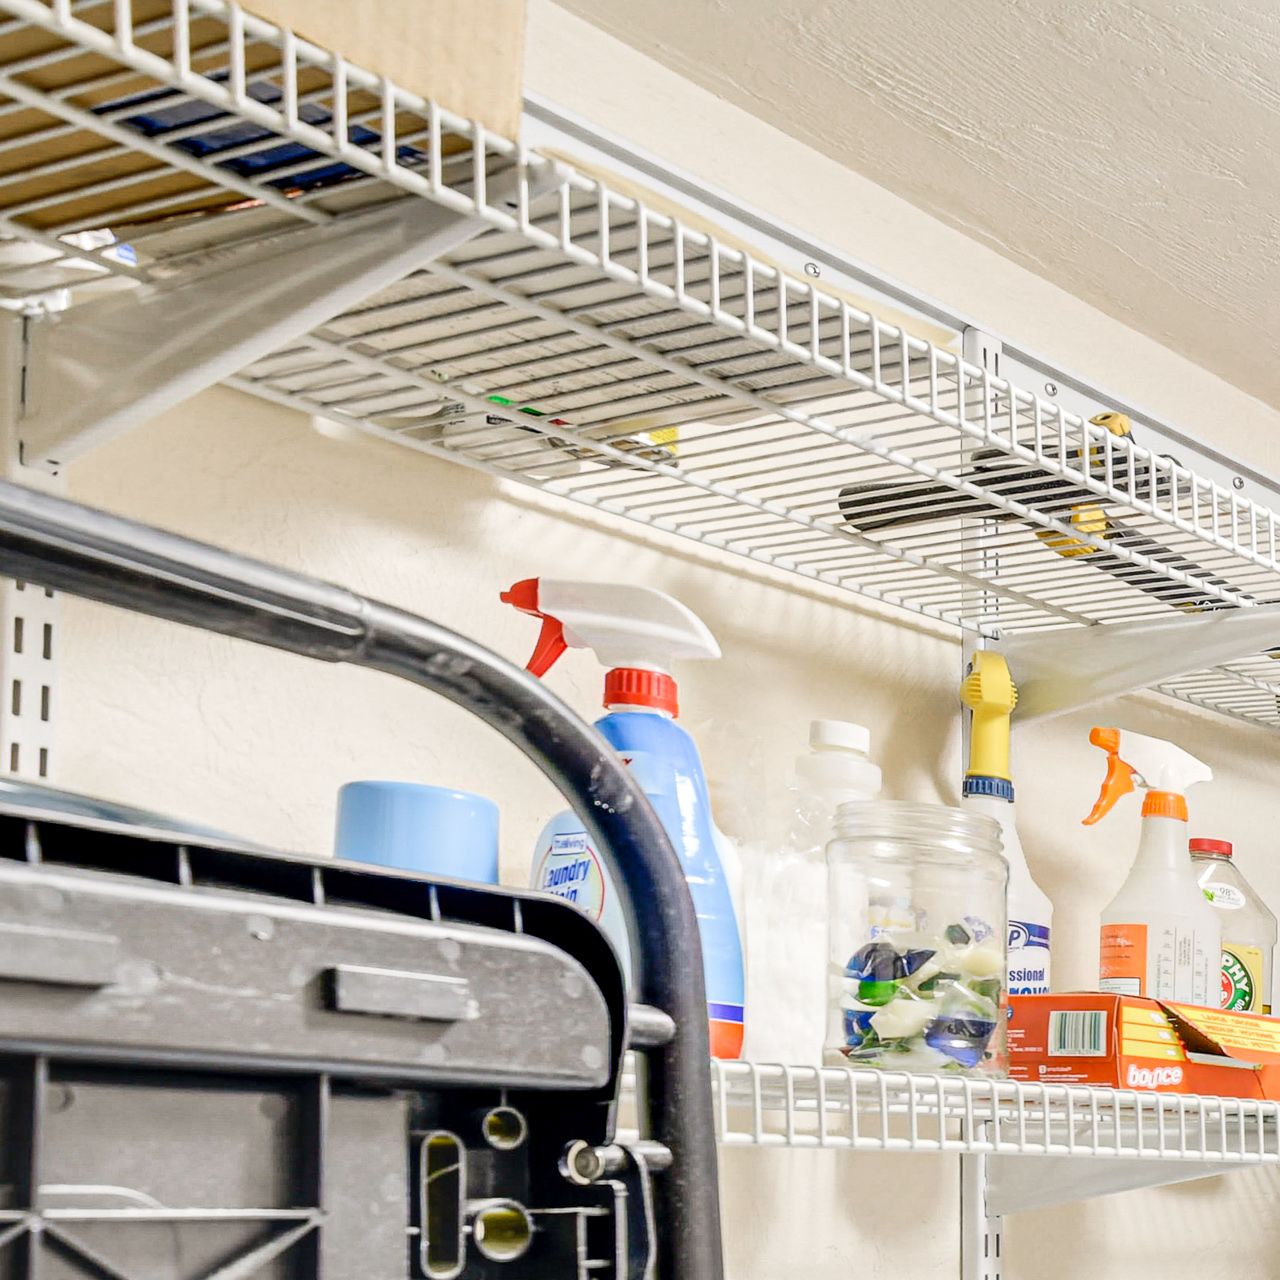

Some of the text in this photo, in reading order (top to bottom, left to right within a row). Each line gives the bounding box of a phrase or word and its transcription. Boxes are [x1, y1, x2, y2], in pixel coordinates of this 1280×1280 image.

[1009, 967, 1045, 983] ssional
[1221, 954, 1250, 992] PHY
[1127, 1063, 1183, 1088] bounce
